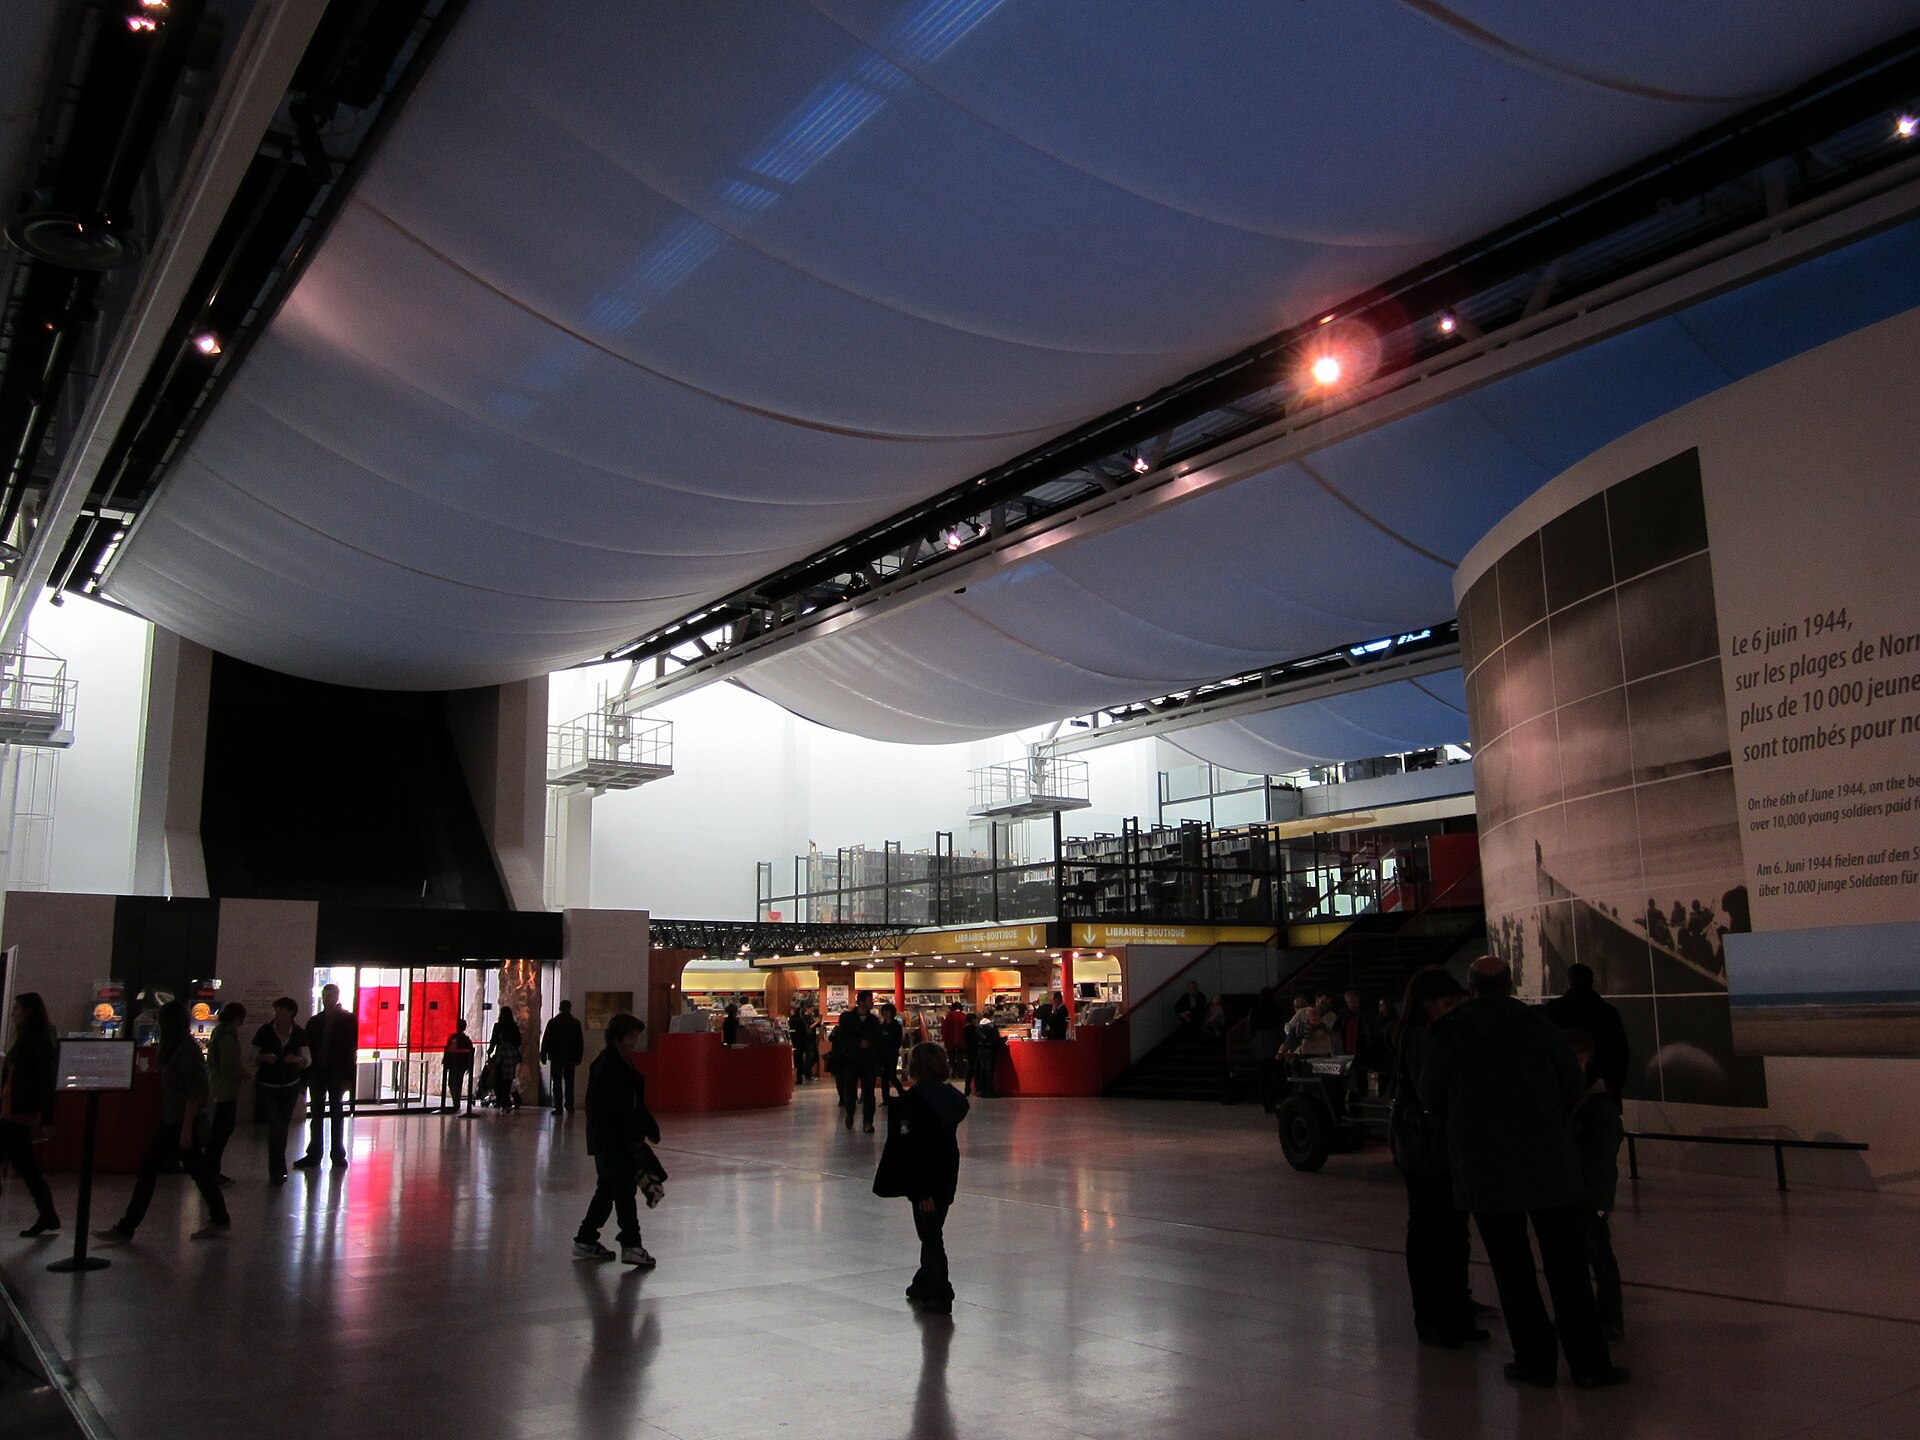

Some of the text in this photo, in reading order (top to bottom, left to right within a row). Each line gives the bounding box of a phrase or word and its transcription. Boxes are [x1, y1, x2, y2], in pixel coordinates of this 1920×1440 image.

[1732, 608, 1853, 656] Le 6 juin 1944,
[1736, 633, 1920, 691] sur les plages de Nor
[1741, 703, 1772, 732] plus
[1778, 696, 1797, 718] de
[1803, 689, 1823, 712] 10
[1828, 681, 1862, 708] 000
[1743, 738, 1778, 762] sont
[1782, 723, 1846, 754] tombés
[1851, 718, 1896, 748] pour
[1748, 799, 1760, 810] On
[1763, 795, 1777, 808] the
[1780, 792, 1795, 806] 6th
[1799, 790, 1809, 804] of
[1810, 788, 1834, 802] June
[1838, 782, 1866, 797] 1944,
[1869, 782, 1883, 793] on
[1886, 777, 1905, 790] the
[1750, 819, 1770, 831] over
[1773, 812, 1805, 828] 10,000
[1808, 810, 1838, 826] young
[1842, 803, 1882, 819] soldiers
[1885, 798, 1911, 815] paid
[1757, 863, 1771, 876] Am
[1774, 862, 1782, 875] 6.
[1785, 859, 1805, 873] Juni
[1808, 856, 1832, 870] 1944
[1835, 854, 1864, 868] fielen
[1867, 849, 1886, 863] auf
[1889, 848, 1909, 861] den
[1759, 871, 1919, 896] über 10.000 junge Soldaten für
[954, 929, 1018, 943] LIBRAIRIE-BOUTIQUE
[1105, 927, 1186, 938] LIBRAIRIE-BOUTIQUE
